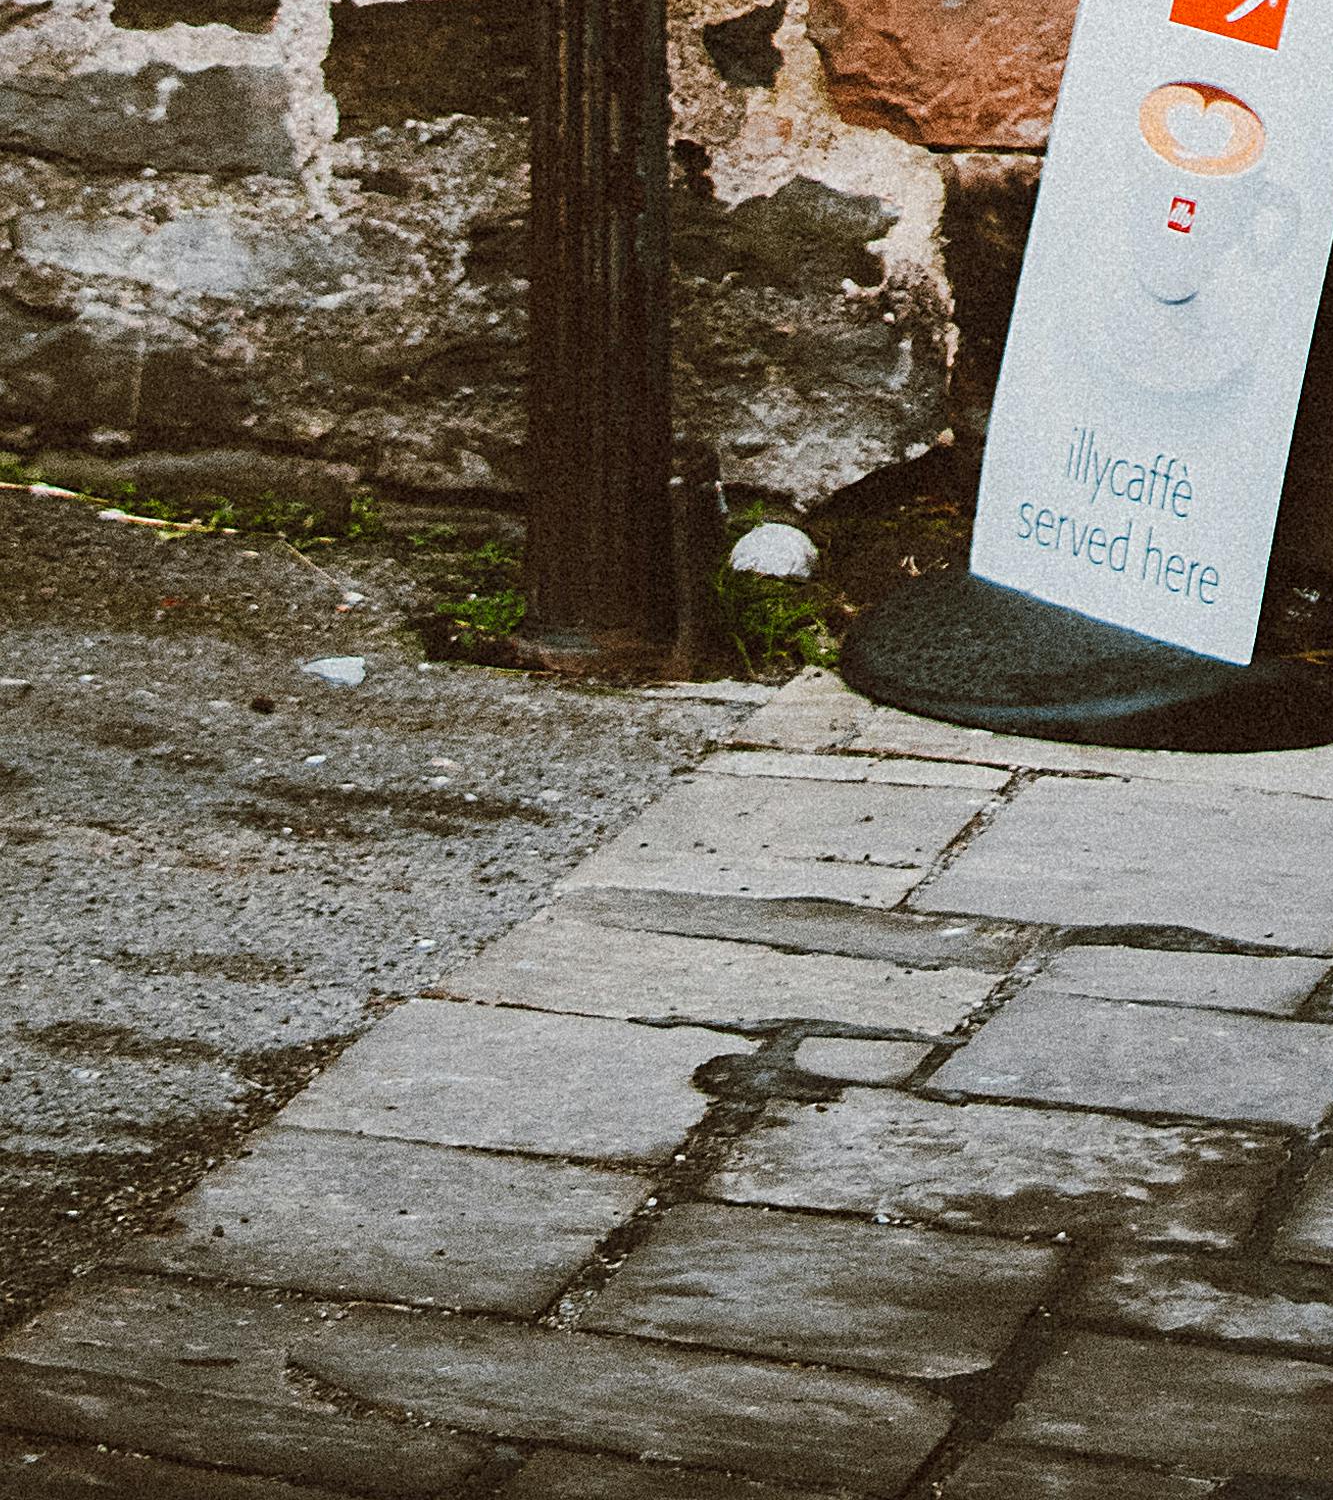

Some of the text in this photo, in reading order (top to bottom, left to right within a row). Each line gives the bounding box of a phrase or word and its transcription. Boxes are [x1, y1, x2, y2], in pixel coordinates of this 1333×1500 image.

[1067, 427, 1193, 518] illycaffè
[1017, 502, 1220, 605] served here
